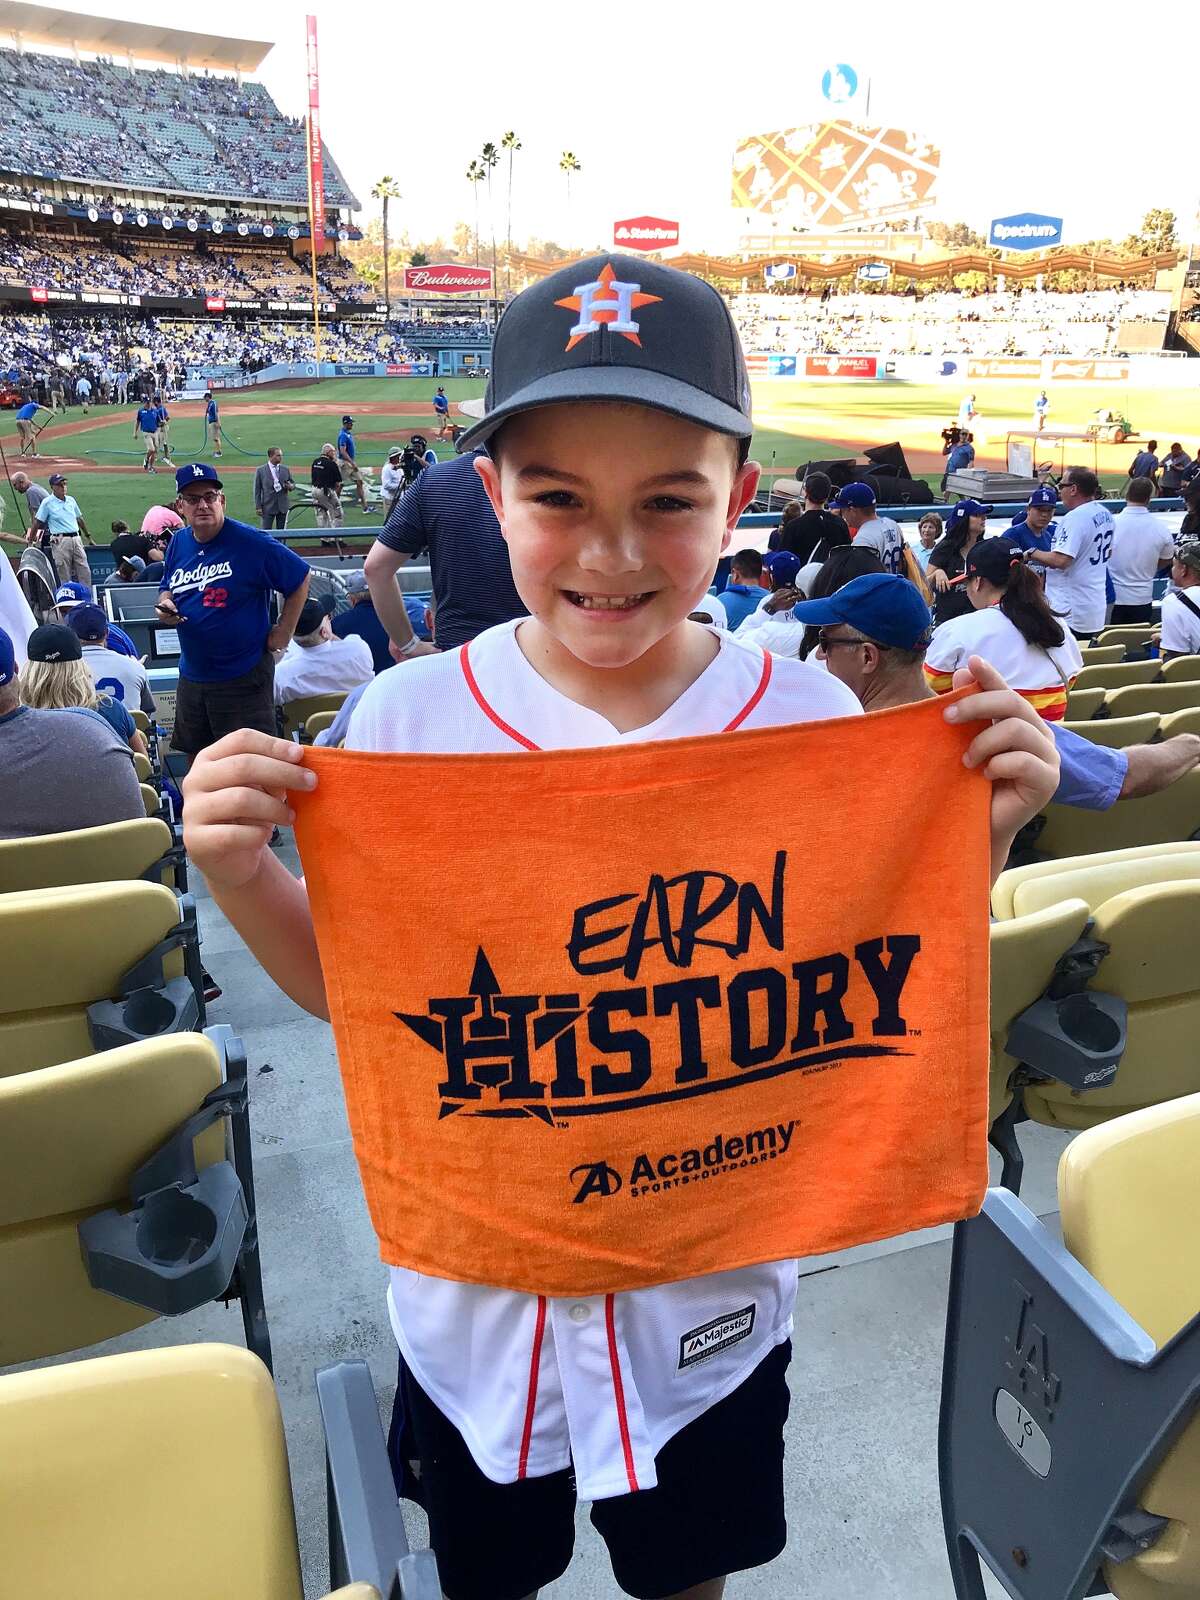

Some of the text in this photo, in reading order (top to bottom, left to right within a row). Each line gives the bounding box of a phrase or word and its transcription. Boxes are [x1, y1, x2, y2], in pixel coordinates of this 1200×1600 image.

[994, 224, 1053, 240] Spectrum
[408, 271, 490, 287] Budweiser
[191, 464, 204, 476] LA
[1089, 530, 1114, 565] 32
[169, 561, 233, 595] Dodgers
[203, 587, 228, 608] 22
[565, 850, 788, 981] EARN
[629, 1120, 795, 1185] Academy
[704, 1316, 748, 1345] Majestic
[1017, 1406, 1033, 1437] 16
